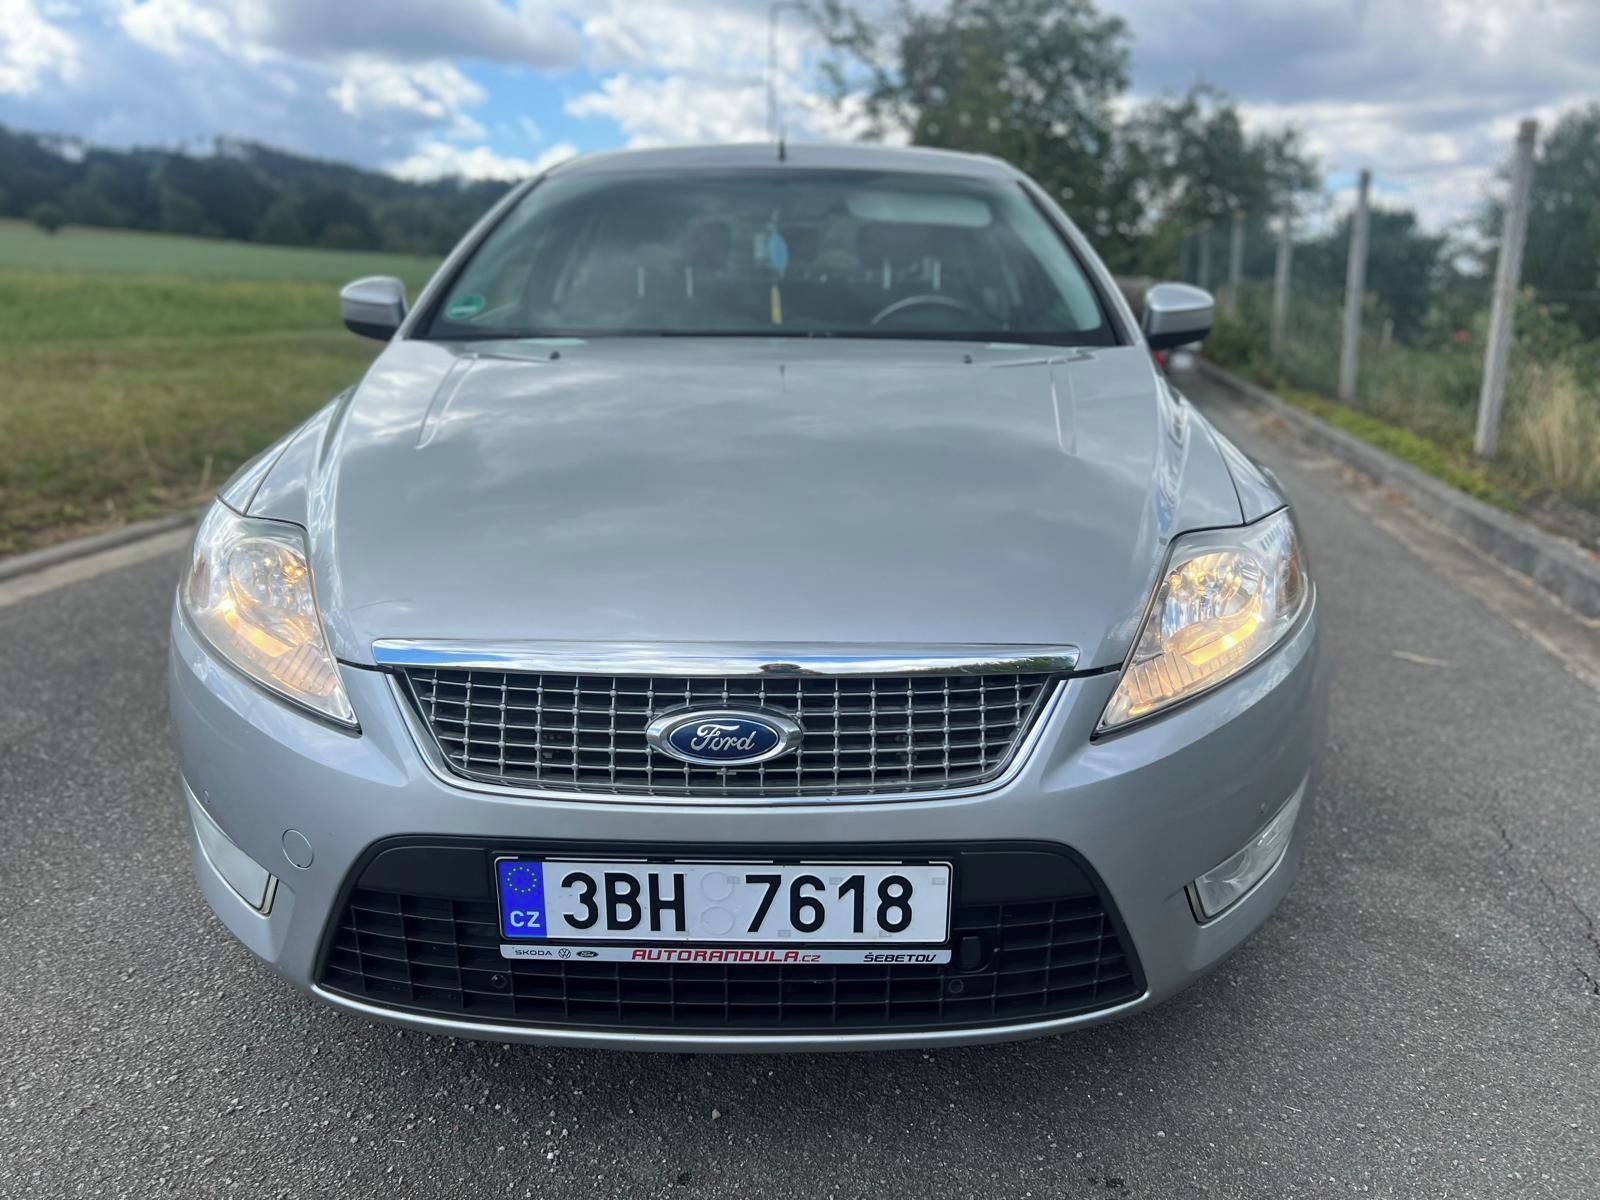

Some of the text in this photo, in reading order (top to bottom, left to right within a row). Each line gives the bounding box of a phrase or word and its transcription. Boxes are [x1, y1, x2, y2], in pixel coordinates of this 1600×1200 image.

[690, 724, 757, 751] Ford
[561, 872, 913, 933] 3BH 7618
[510, 911, 541, 928] CZ
[863, 952, 937, 963] ŠEBETOV
